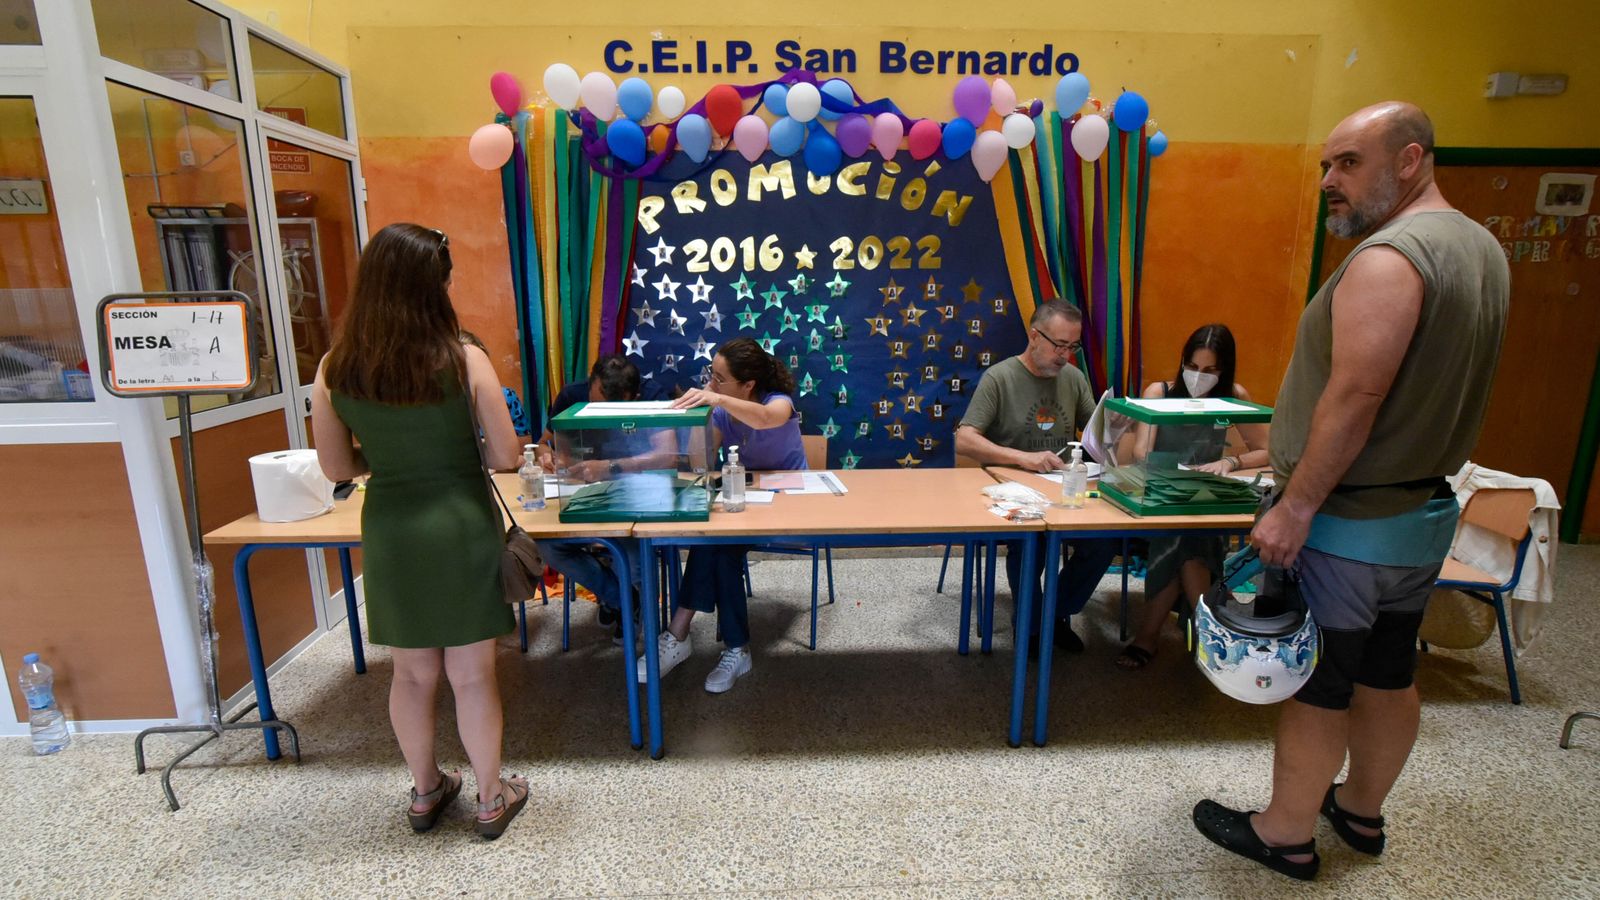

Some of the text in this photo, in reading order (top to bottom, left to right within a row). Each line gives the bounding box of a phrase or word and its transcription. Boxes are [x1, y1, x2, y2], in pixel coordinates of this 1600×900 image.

[603, 39, 1080, 76] C.E.I.P. San Bernardo
[294, 155, 305, 163] DE
[682, 233, 942, 273] 2016 2022
[111, 310, 158, 320] SECCIÓN
[114, 335, 221, 354] MESA A
